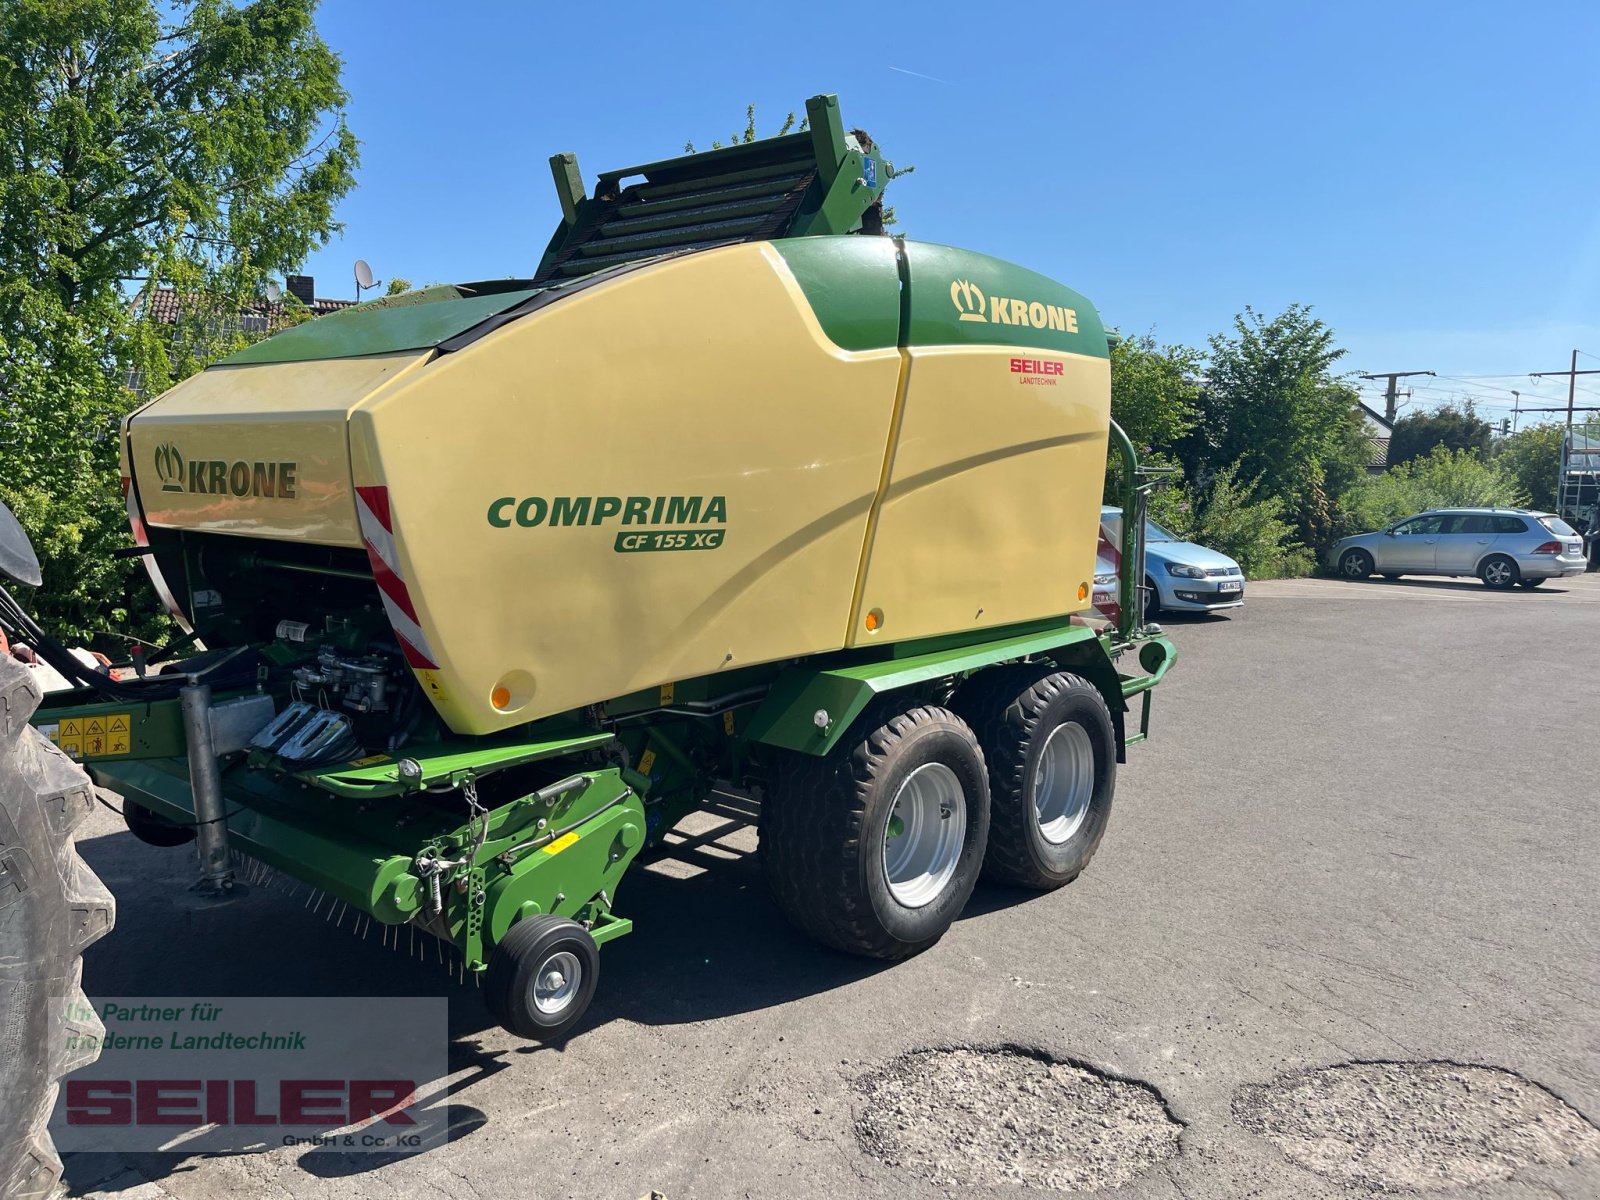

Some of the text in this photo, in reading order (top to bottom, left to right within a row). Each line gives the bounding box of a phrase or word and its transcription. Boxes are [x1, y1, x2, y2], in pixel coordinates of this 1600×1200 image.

[990, 296, 1079, 334] KRONE
[1010, 358, 1064, 376] SEILER
[1019, 376, 1057, 386] LANDTECHNIK
[188, 460, 297, 499] KRONE
[487, 495, 727, 529] COMPRIMA
[622, 533, 719, 549] CF 155 XC
